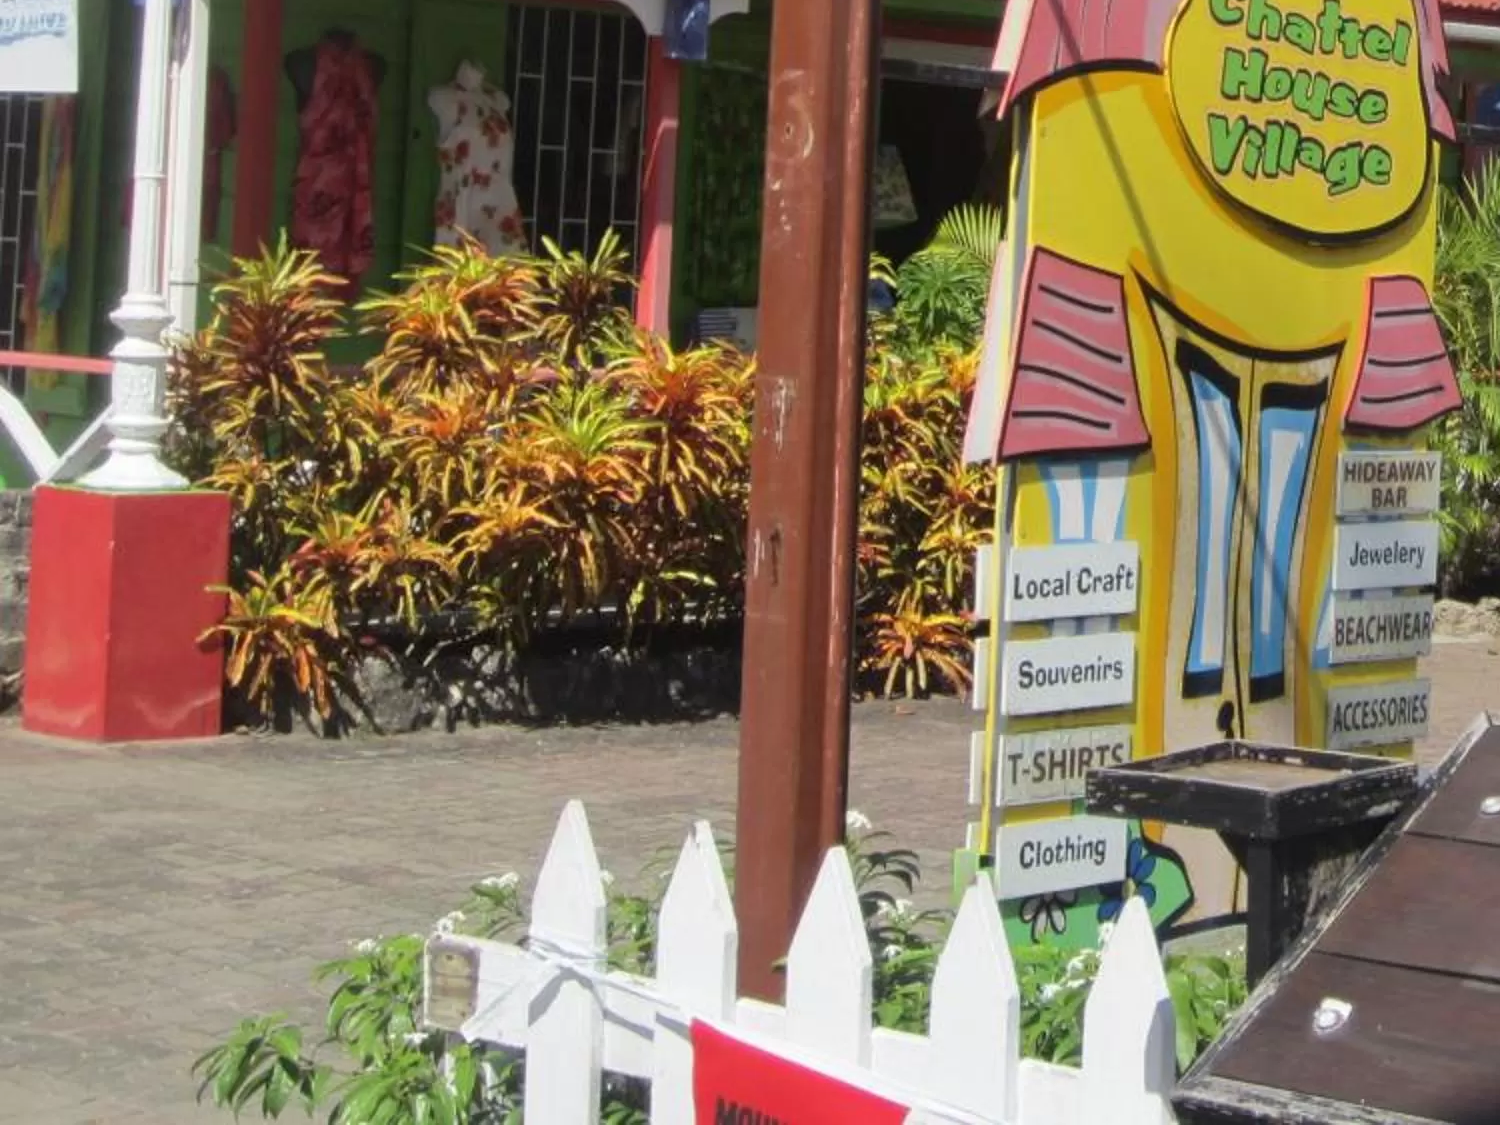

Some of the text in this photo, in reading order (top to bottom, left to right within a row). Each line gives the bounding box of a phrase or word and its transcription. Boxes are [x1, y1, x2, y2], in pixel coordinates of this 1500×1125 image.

[1220, 47, 1388, 123] House
[1207, 113, 1392, 196] Village
[1343, 459, 1437, 484] HIDEAWAY
[1371, 486, 1408, 509] BAR
[1349, 538, 1425, 569] Jewelery
[1014, 562, 1134, 601] Local Craft
[1335, 611, 1432, 646] BEACHWEAR
[1018, 655, 1123, 690] Souvenirs
[1332, 694, 1427, 732] ACCESSORIES
[1019, 834, 1107, 869] Clothing
